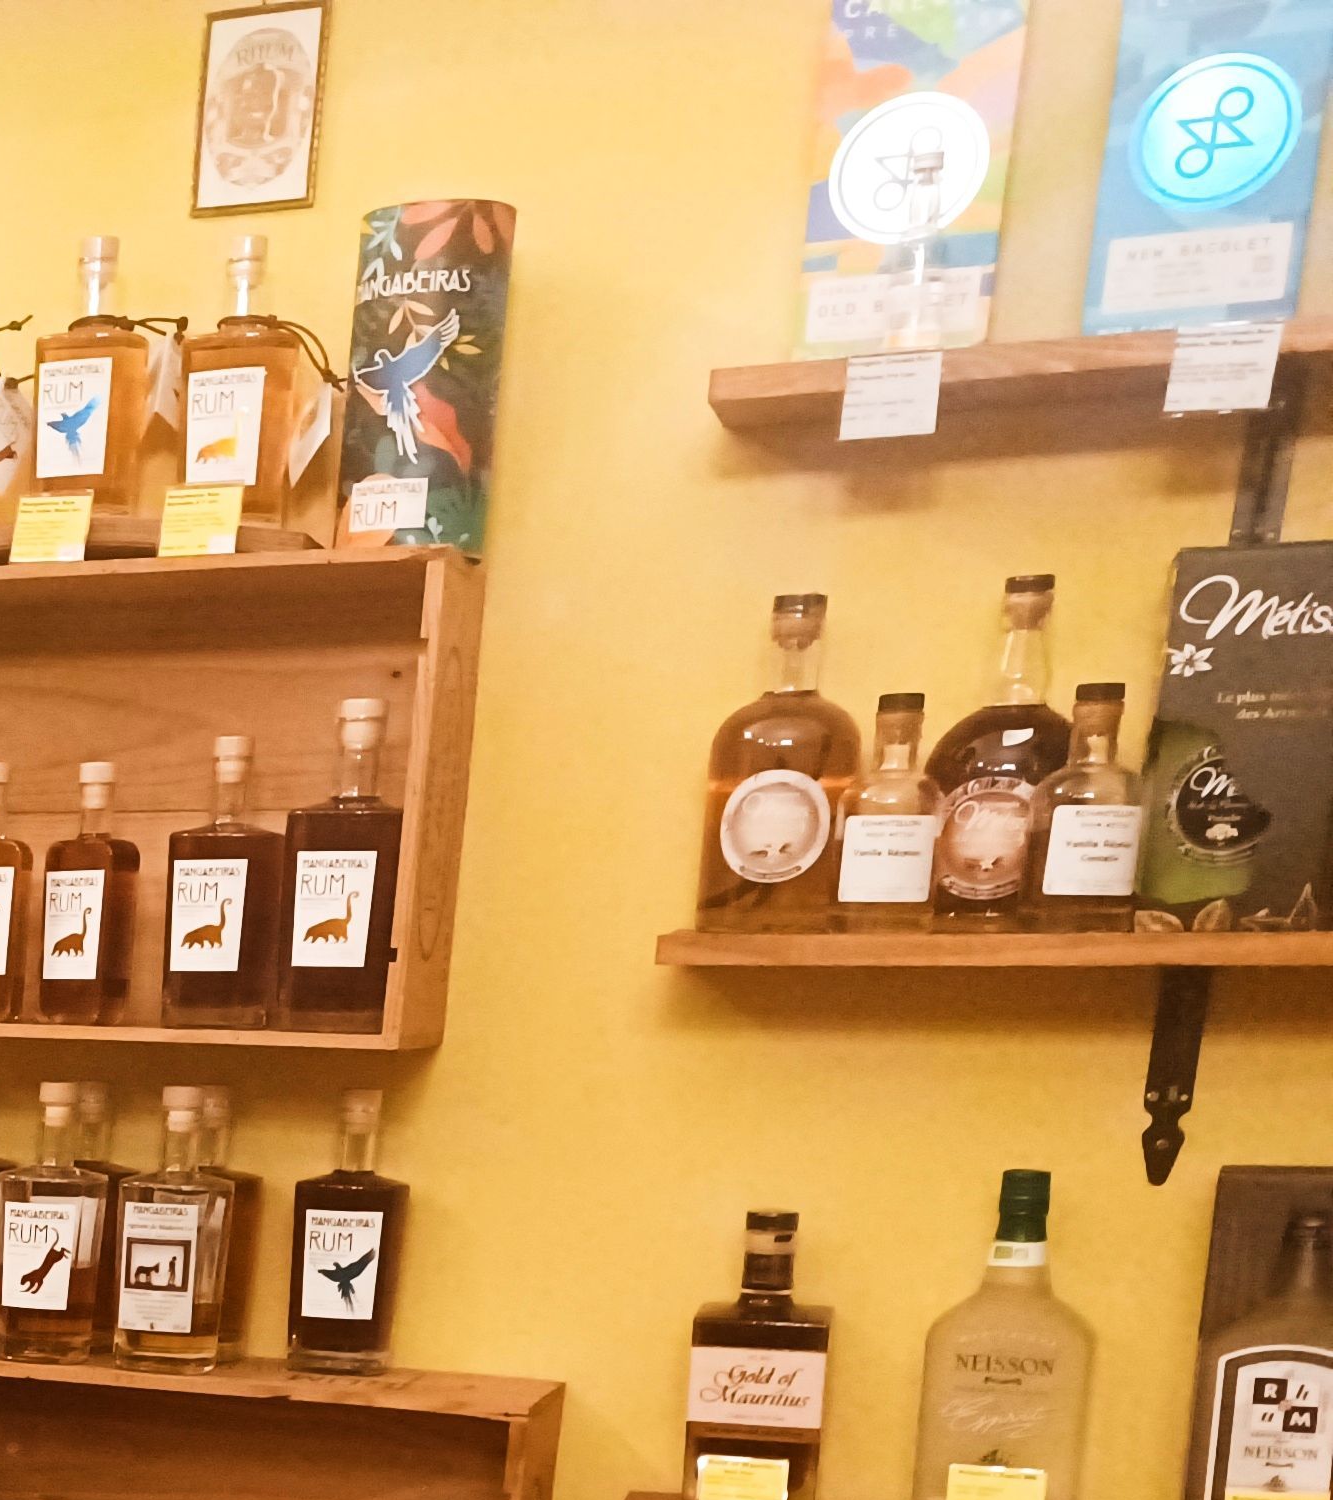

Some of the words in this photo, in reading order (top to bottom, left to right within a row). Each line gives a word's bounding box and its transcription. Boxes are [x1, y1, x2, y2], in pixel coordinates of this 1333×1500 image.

[43, 381, 83, 405] RUM
[191, 391, 235, 415] RUM
[353, 500, 397, 527] RUM
[1180, 574, 1333, 640] Métis
[179, 867, 241, 877] MANGABEIRAS
[302, 859, 369, 869] MANGABEIRAS
[50, 878, 99, 887] MANGABEIRAS
[177, 882, 219, 903] RUM
[300, 874, 345, 895] RUM
[49, 892, 82, 912] RUM
[9, 1209, 70, 1220] MANGABEIRAS
[133, 1205, 189, 1217] MANGABEIRAS
[311, 1216, 376, 1228] MANGABEIRAS
[8, 1222, 49, 1244] RUM
[308, 1230, 354, 1252] RUM
[956, 1353, 1057, 1376] NEISSON
[714, 1365, 776, 1388] Gold
[778, 1368, 805, 1391] of
[700, 1385, 811, 1408] Mauritius
[1263, 1383, 1277, 1398] R
[1289, 1412, 1312, 1427] M
[1243, 1446, 1318, 1461] NEISSON
